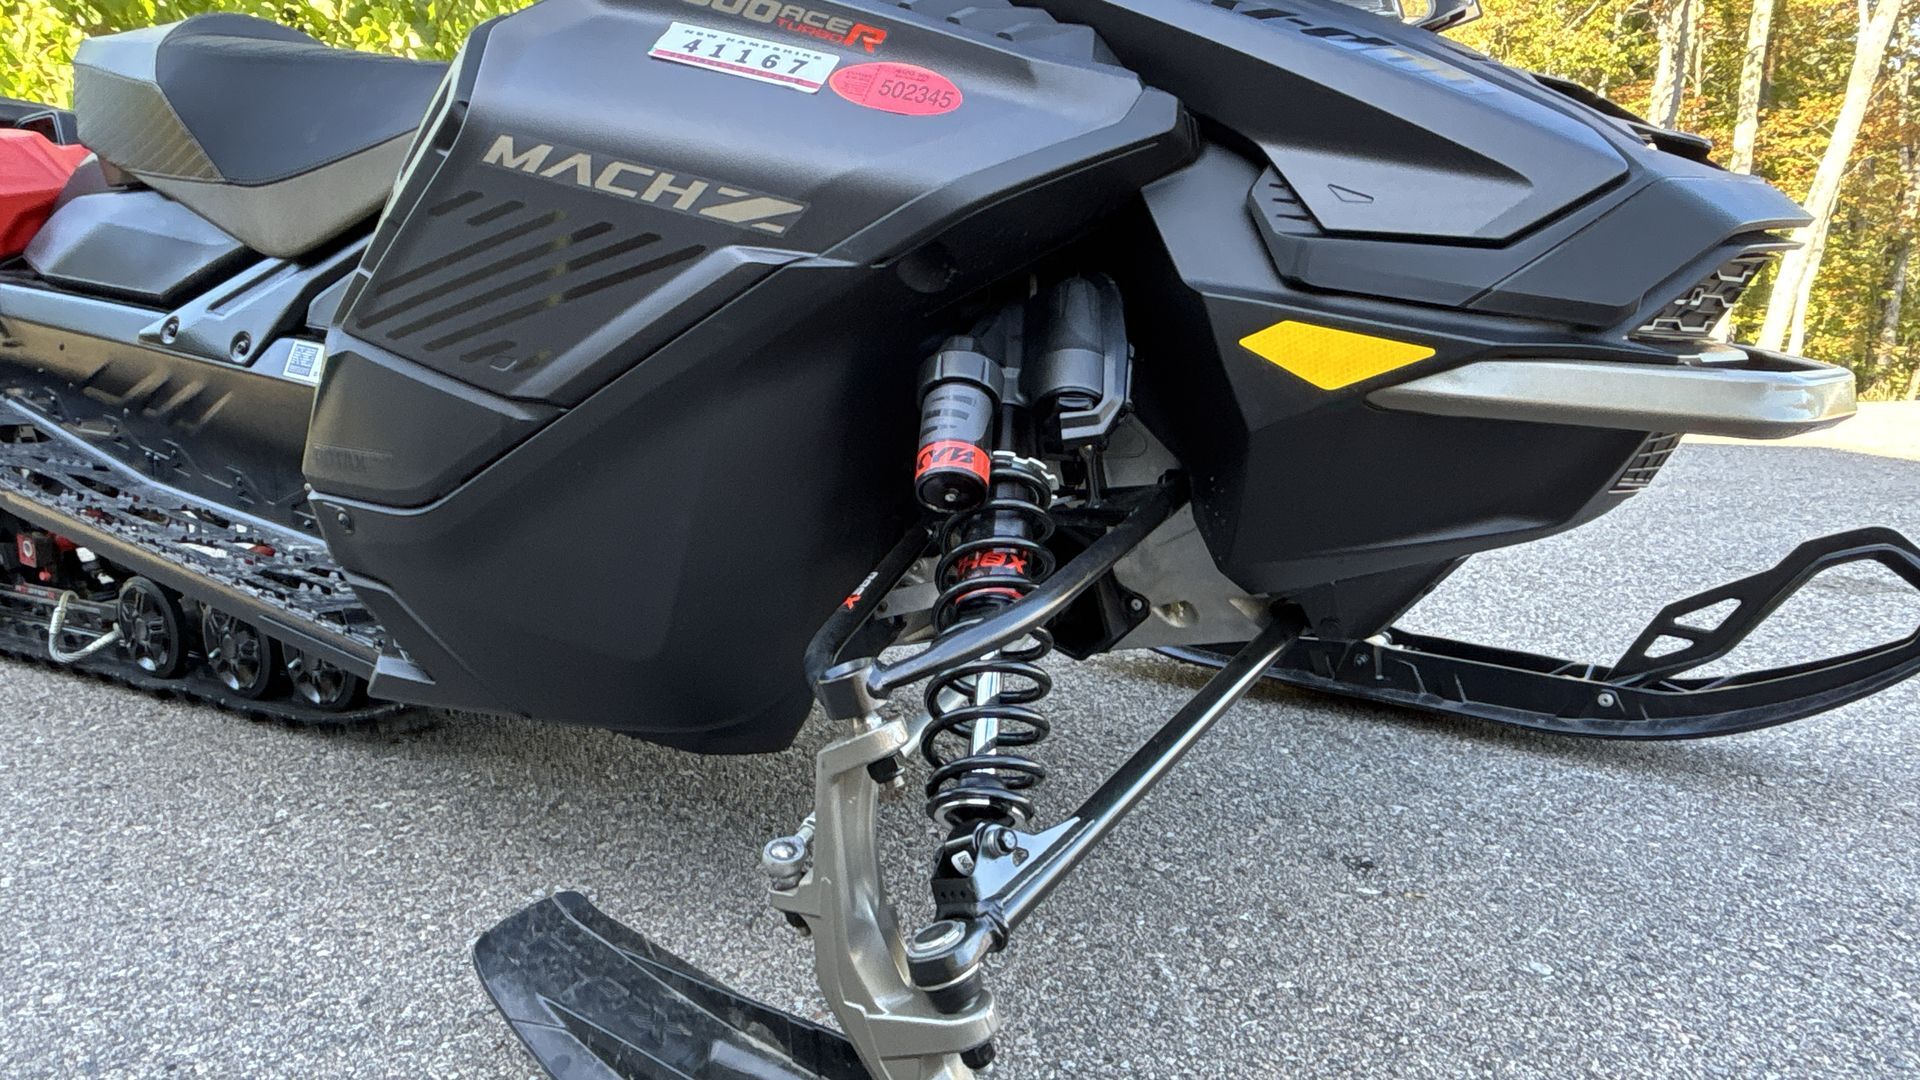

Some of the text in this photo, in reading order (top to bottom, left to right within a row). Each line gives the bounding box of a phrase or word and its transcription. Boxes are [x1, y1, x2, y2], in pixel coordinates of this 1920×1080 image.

[682, 0, 783, 24] 00
[682, 38, 809, 74] 41167
[878, 79, 955, 109] 502345
